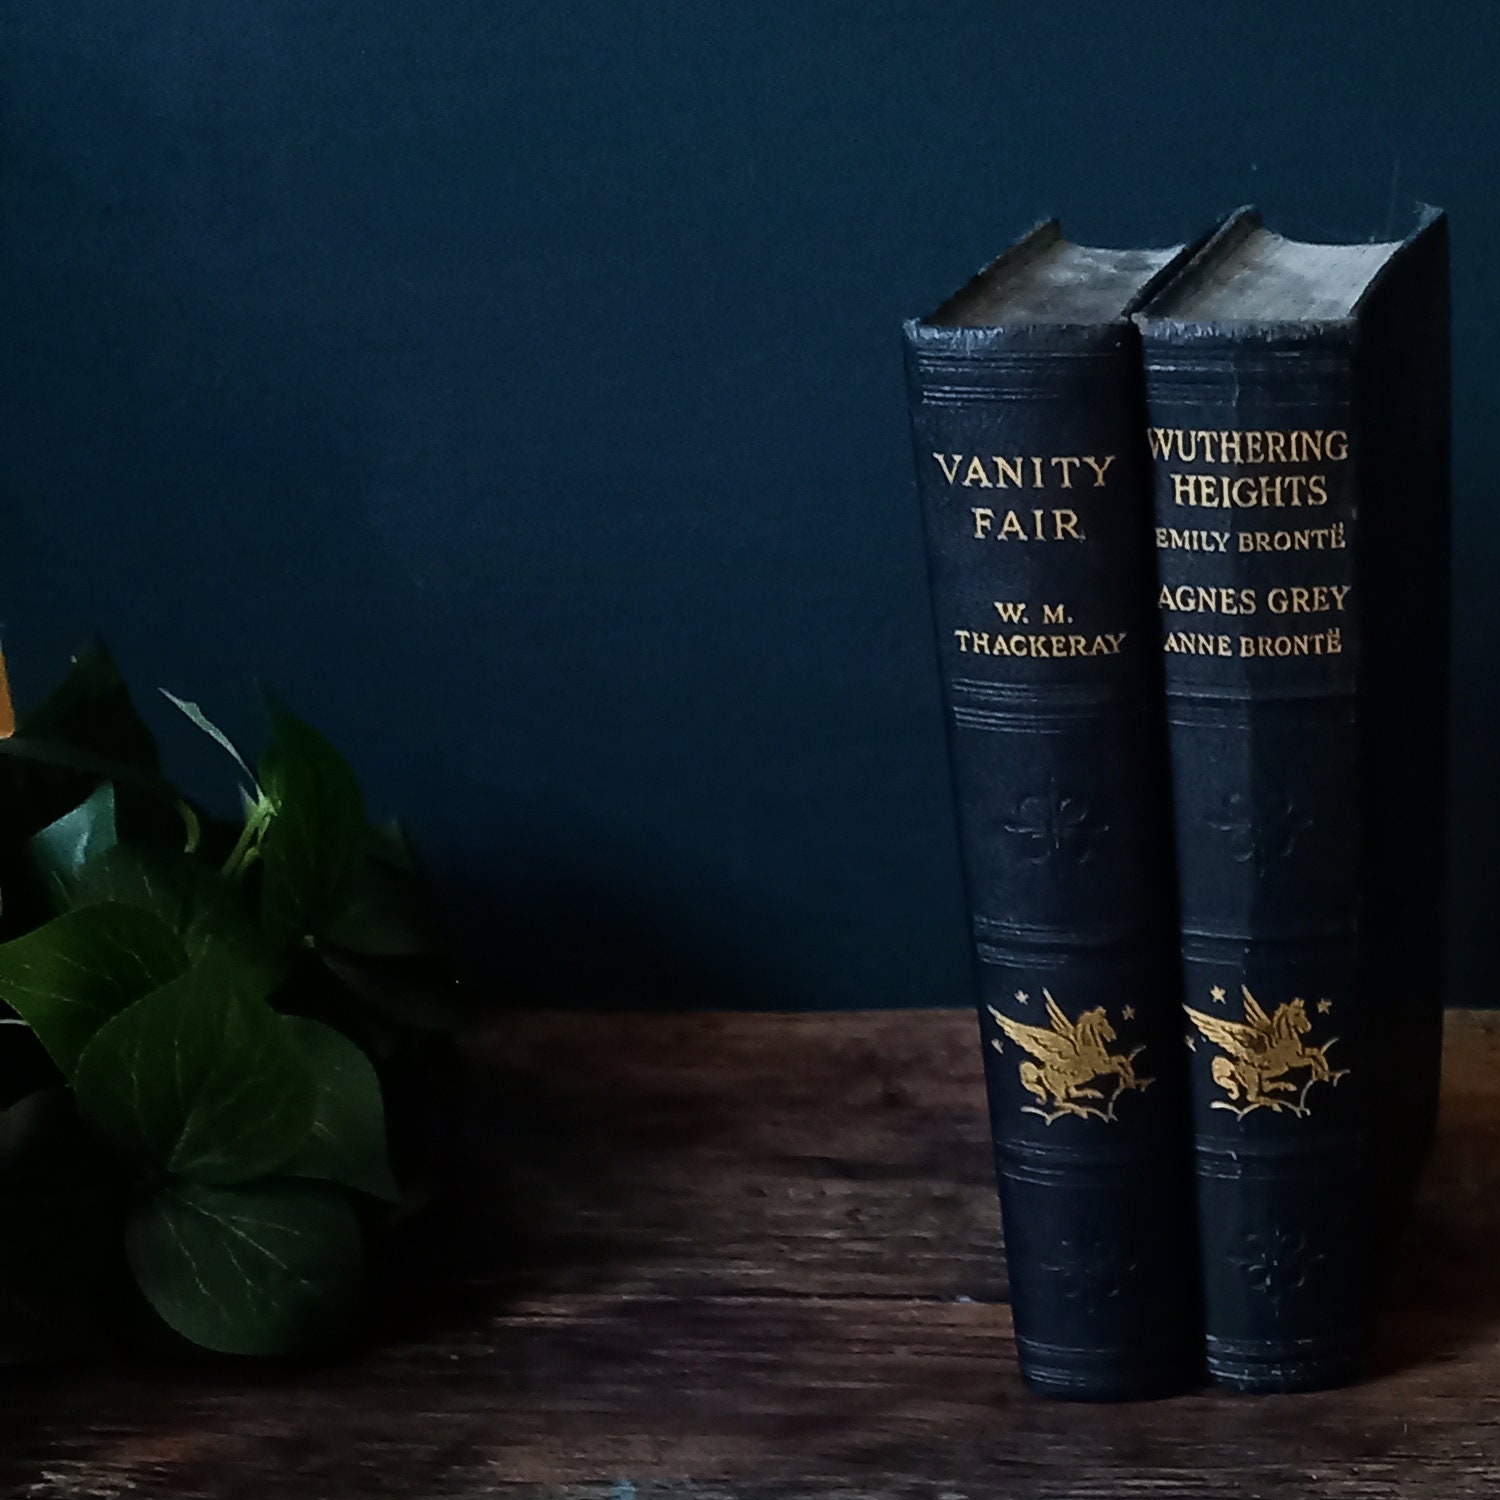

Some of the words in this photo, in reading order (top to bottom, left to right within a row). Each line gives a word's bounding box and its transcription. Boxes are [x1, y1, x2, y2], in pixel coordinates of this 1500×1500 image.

[1147, 428, 1349, 464] WUTHERING
[933, 452, 1116, 489] VANITY
[1171, 474, 1328, 507] HEIGHTS
[972, 508, 1083, 541] FAIR
[1155, 527, 1230, 552] EMILY
[1239, 522, 1345, 552] BRONTË
[995, 602, 1030, 624] W.
[1043, 604, 1073, 624] M.
[1158, 585, 1256, 615] AGNES
[1268, 585, 1351, 614] GREY
[954, 631, 1127, 658] THACKERAY
[1163, 632, 1232, 657] ANNE
[1240, 628, 1342, 658] BRONTË
